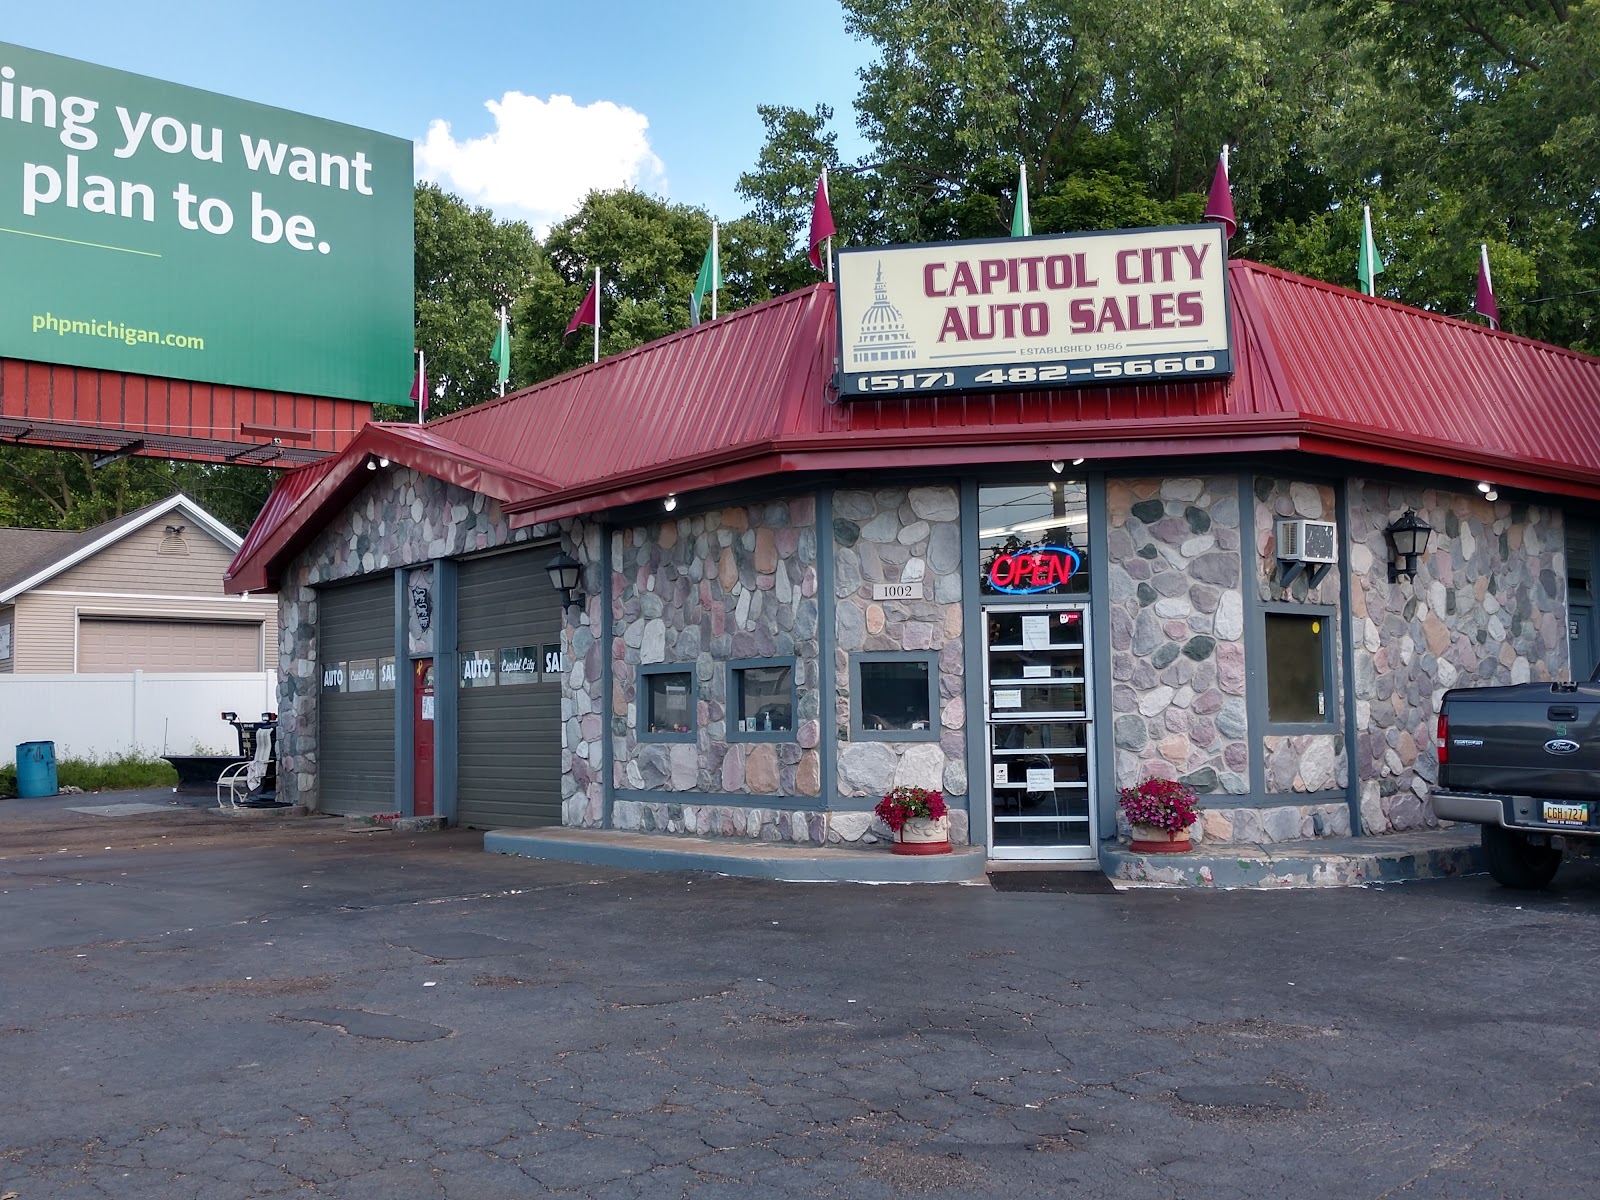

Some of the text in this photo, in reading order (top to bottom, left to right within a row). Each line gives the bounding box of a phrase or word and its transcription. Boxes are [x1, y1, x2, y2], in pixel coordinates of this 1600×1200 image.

[1, 66, 374, 196] ing you want
[23, 154, 331, 255] plan to be.
[922, 243, 1212, 299] CAPITOL CITY
[936, 291, 1205, 343] AUTO SALES
[32, 311, 205, 351] phpmichigan.com
[1020, 342, 1123, 356] ESTABLISHED 1986
[857, 355, 1217, 393] (517) 482-5660
[991, 554, 1072, 587] OPEN
[884, 585, 912, 597] 1002
[323, 669, 344, 687] AUTO
[464, 658, 491, 679] AUTO
[522, 657, 536, 674] City
[1556, 722, 1567, 737] S
[1551, 741, 1571, 751] Ford
[1547, 807, 1583, 820] CGH 727
